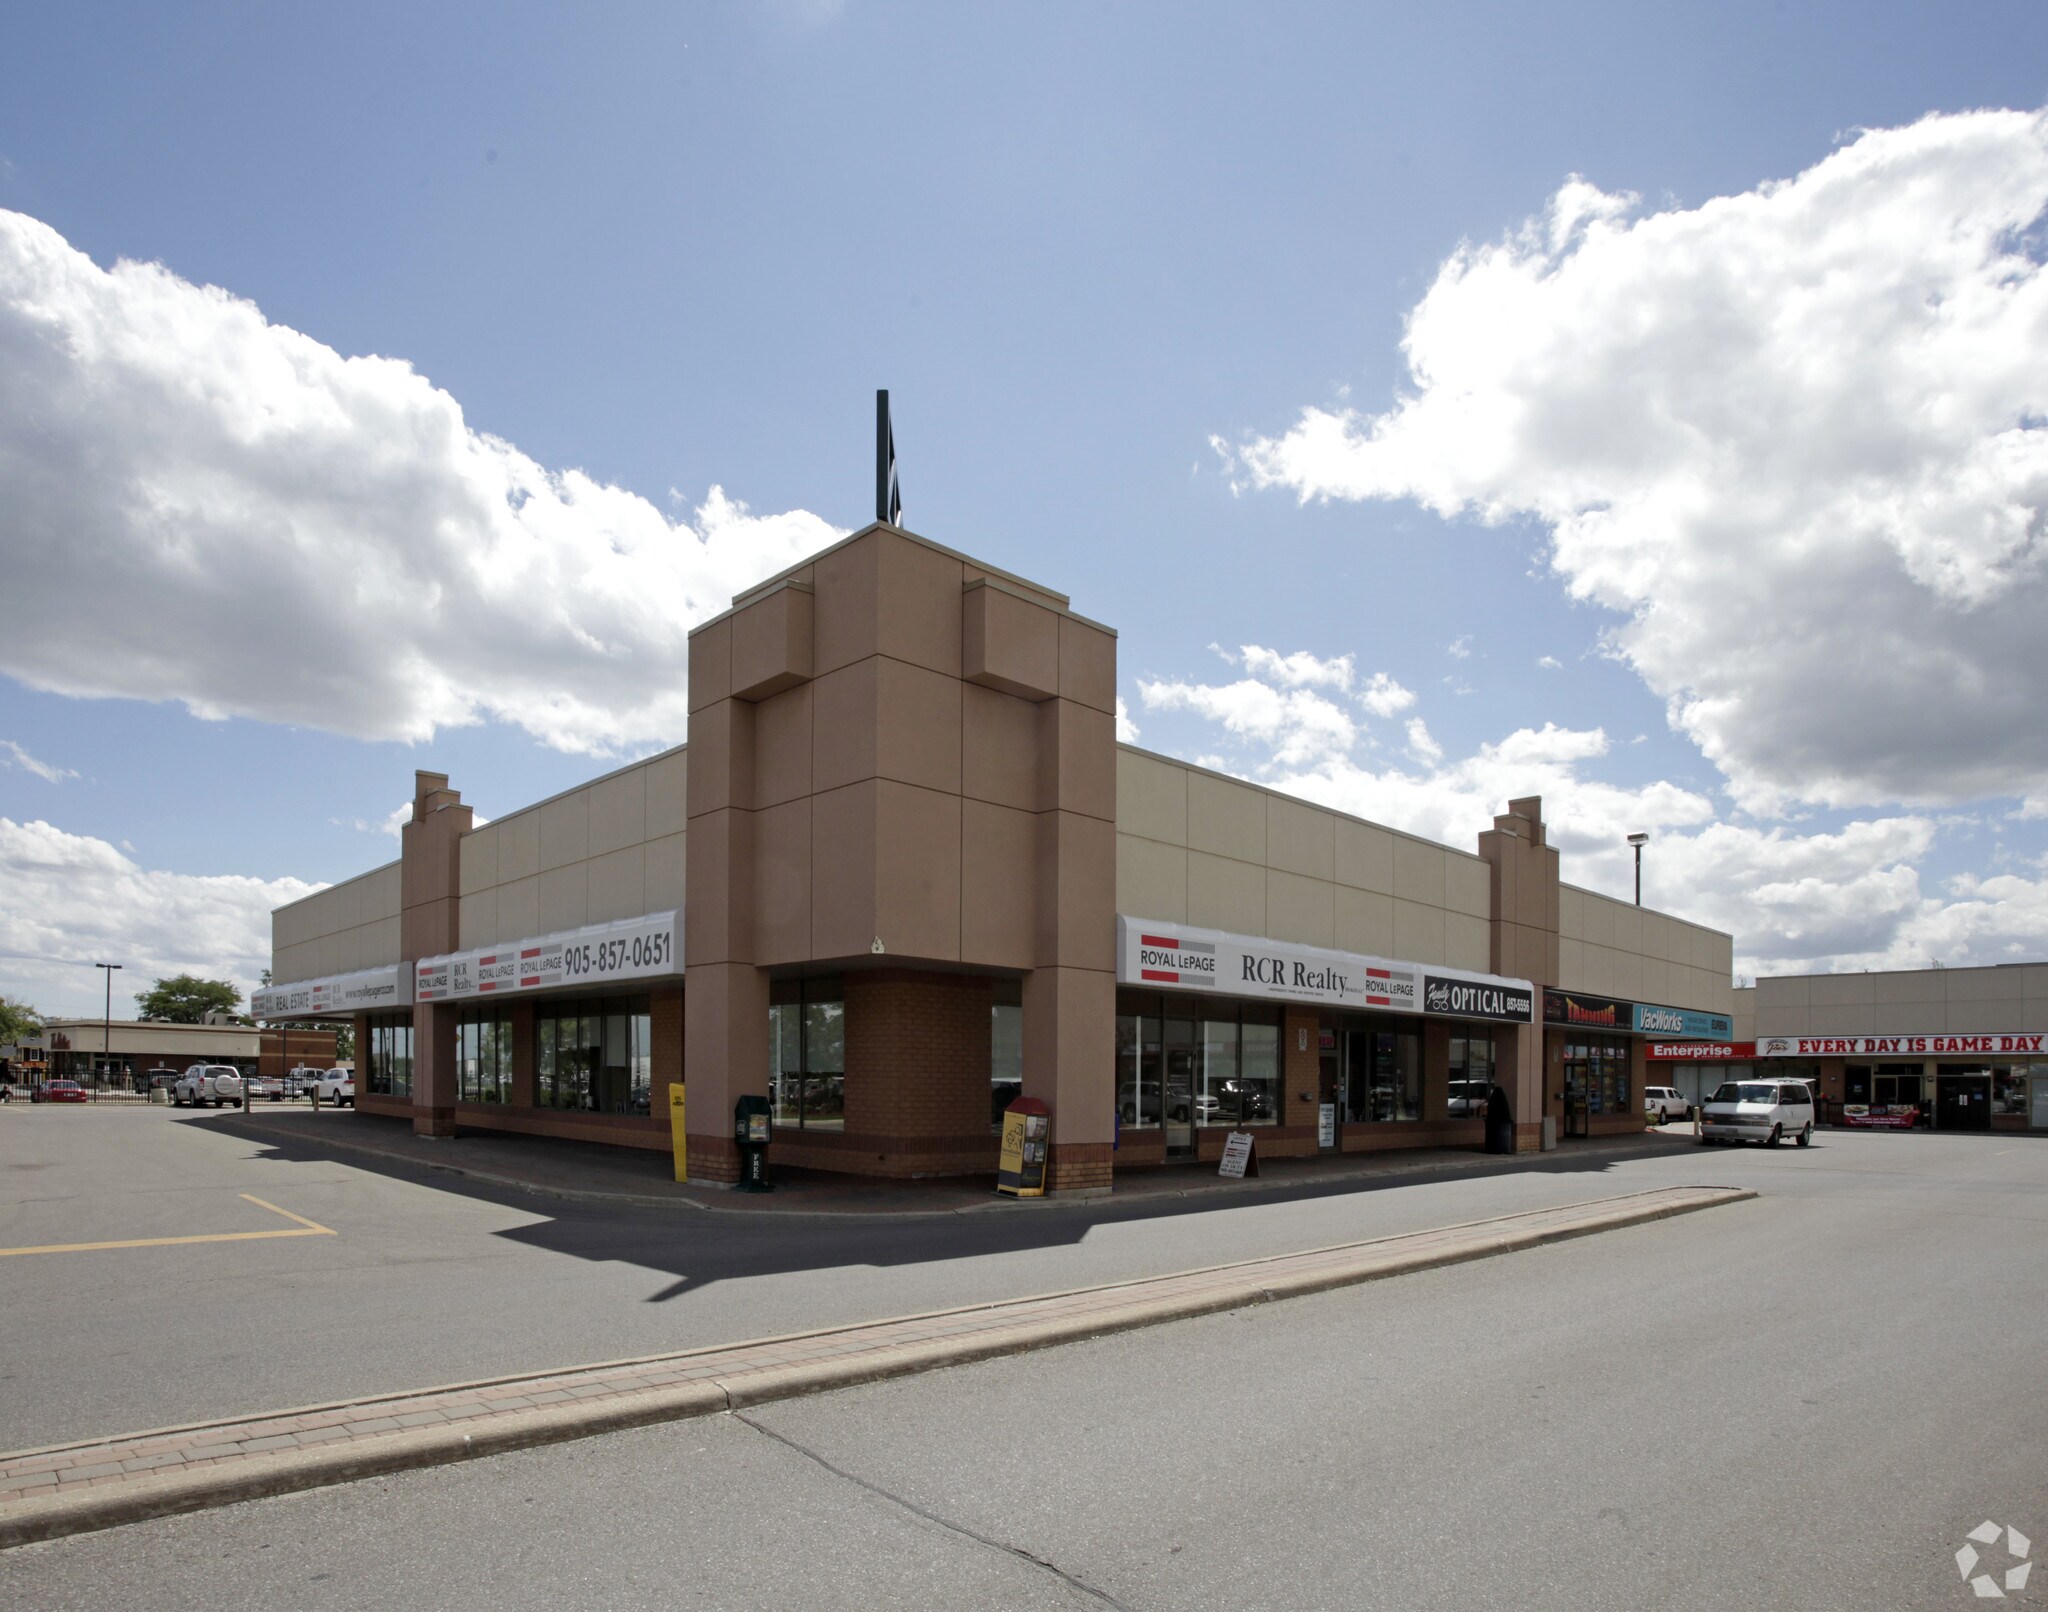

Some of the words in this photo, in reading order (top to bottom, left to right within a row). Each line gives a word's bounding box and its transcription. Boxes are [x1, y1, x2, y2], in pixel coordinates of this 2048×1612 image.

[565, 931, 670, 975] 905-857-0651
[1141, 950, 1175, 967] ROYAL
[454, 963, 467, 977] RCR
[479, 969, 495, 980] ROYAL
[520, 962, 539, 974] ROYAL
[1241, 954, 1286, 985] RCR
[1293, 961, 1348, 997] Realty
[419, 979, 431, 989] ROYAL
[454, 978, 471, 991] Realty
[1365, 980, 1388, 994] ROYAL
[276, 995, 289, 1011] REAL
[290, 992, 309, 1009] ESTATE
[1451, 986, 1506, 1014] OPTICAL
[1566, 996, 1616, 1025] TANNING
[1640, 1008, 1682, 1032] VacWorks
[1653, 1045, 1732, 1058] Enterprise
[1798, 1040, 1858, 1052] EVERY
[1864, 1039, 1901, 1052] DAY
[1907, 1038, 1926, 1051] IS
[1933, 1037, 1993, 1051] GAME
[2000, 1036, 2043, 1050] DAY
